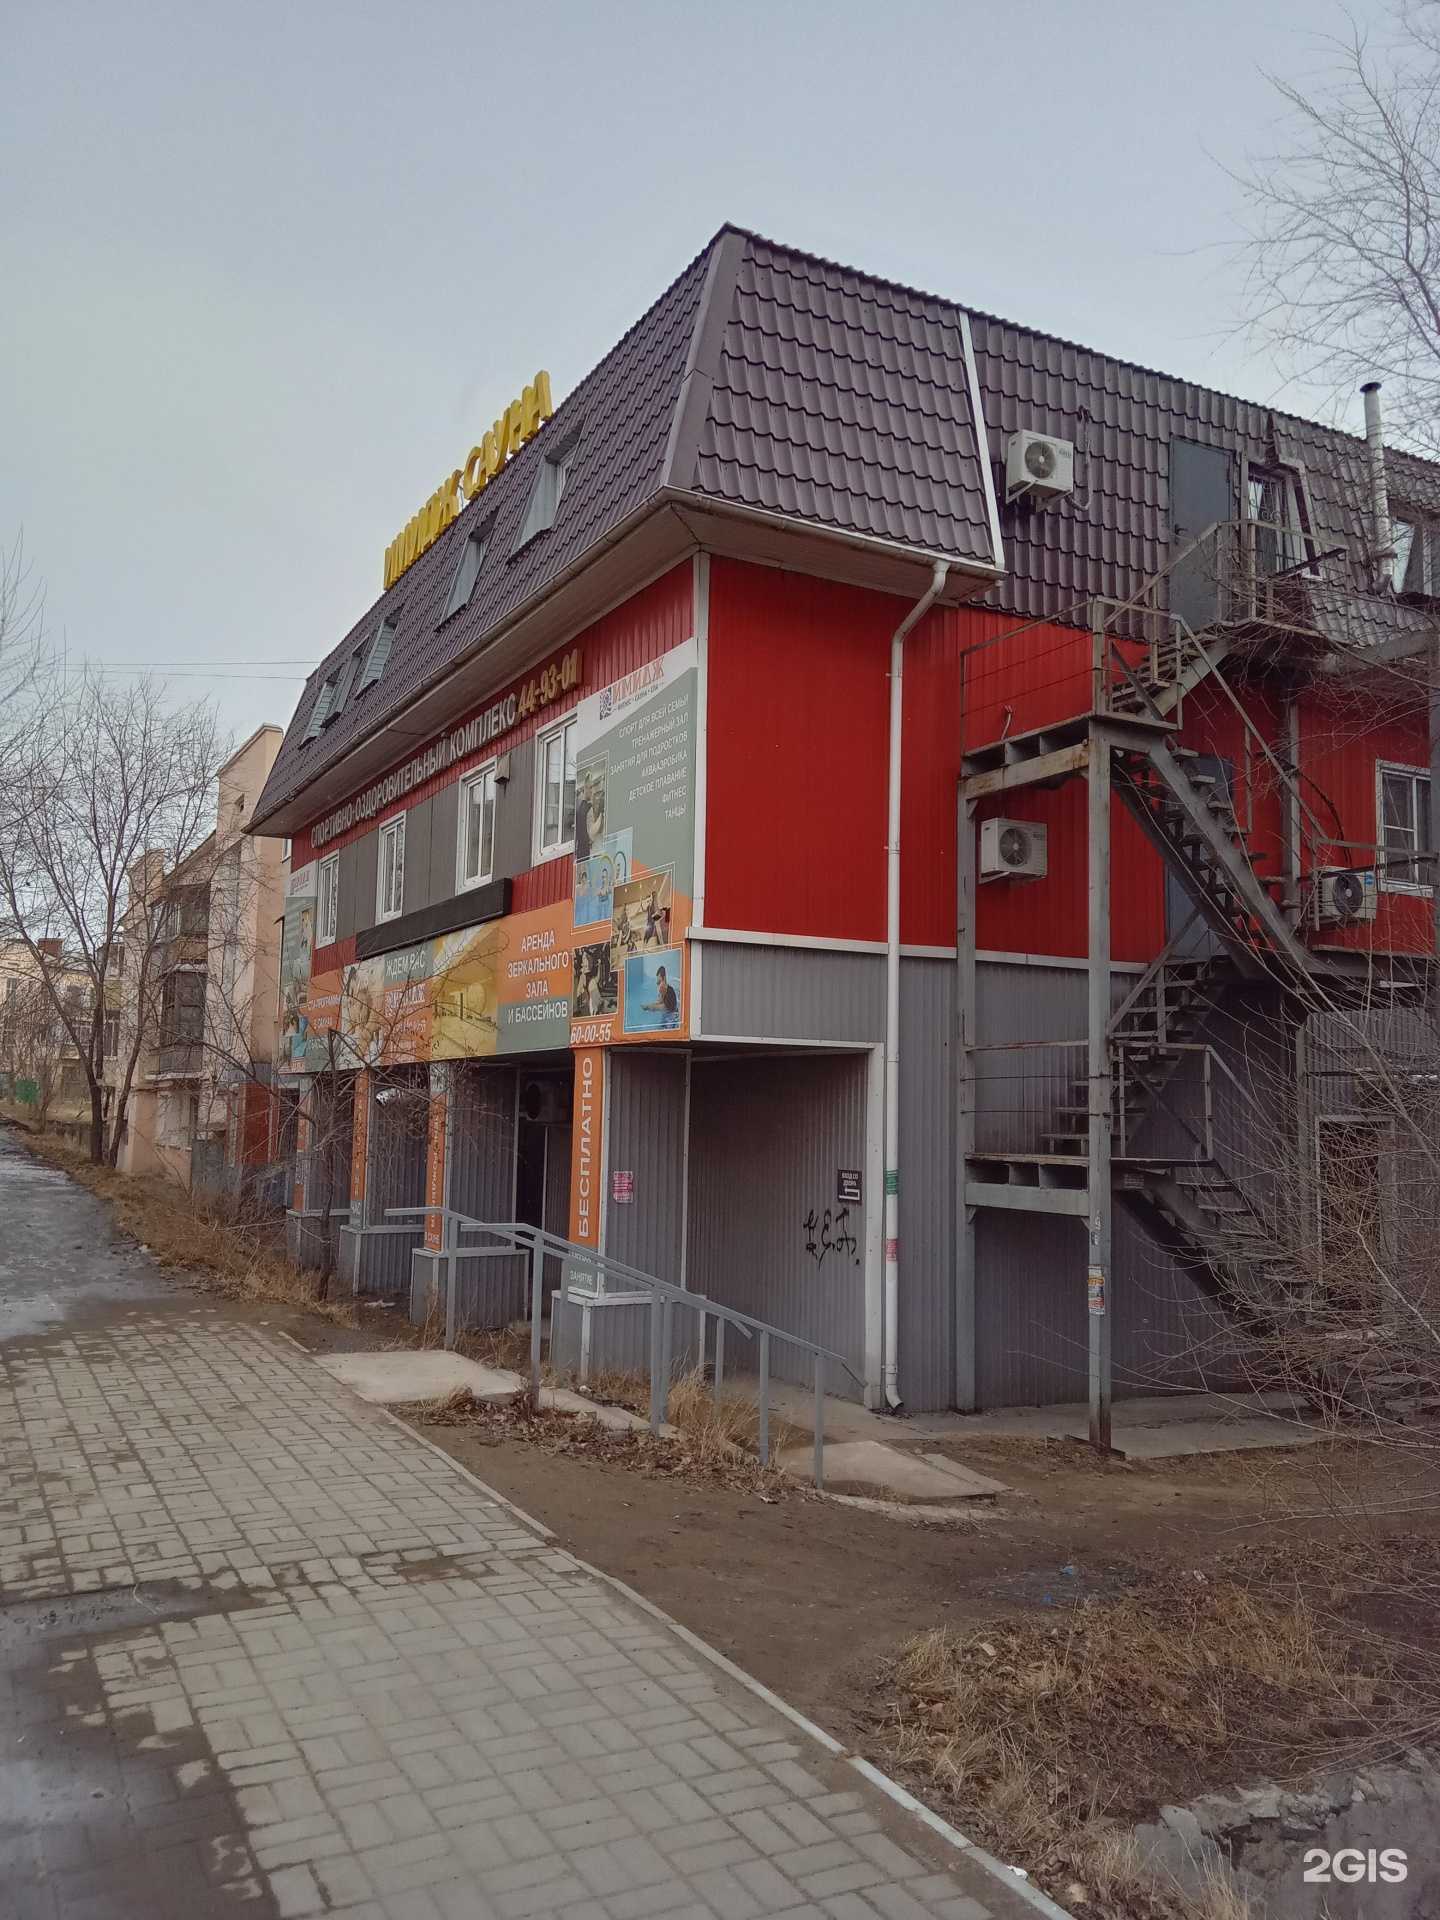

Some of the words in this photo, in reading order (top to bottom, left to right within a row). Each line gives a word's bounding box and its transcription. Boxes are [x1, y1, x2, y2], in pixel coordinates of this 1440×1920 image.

[613, 656, 665, 705] ИМИДЖ
[618, 721, 638, 739] СПОРТ
[311, 731, 449, 848] СПОРТИВНО-ОЗДОРОВИТЕЛЬНЫЙ
[450, 693, 517, 763] КОМПЛЕКС
[517, 648, 580, 717] 44-93-01
[520, 930, 555, 954] АРЕНДА
[386, 955, 410, 980] ЖДЕМ
[507, 951, 570, 979] ЗЕРКАЛЬНОГО
[525, 979, 549, 998] ЗАЛА
[507, 1008, 515, 1024] И
[515, 999, 568, 1024] БАССЕЙНОВ
[570, 1022, 612, 1044] 60-00-55
[578, 1057, 594, 1238] БЕСПЛАТНО
